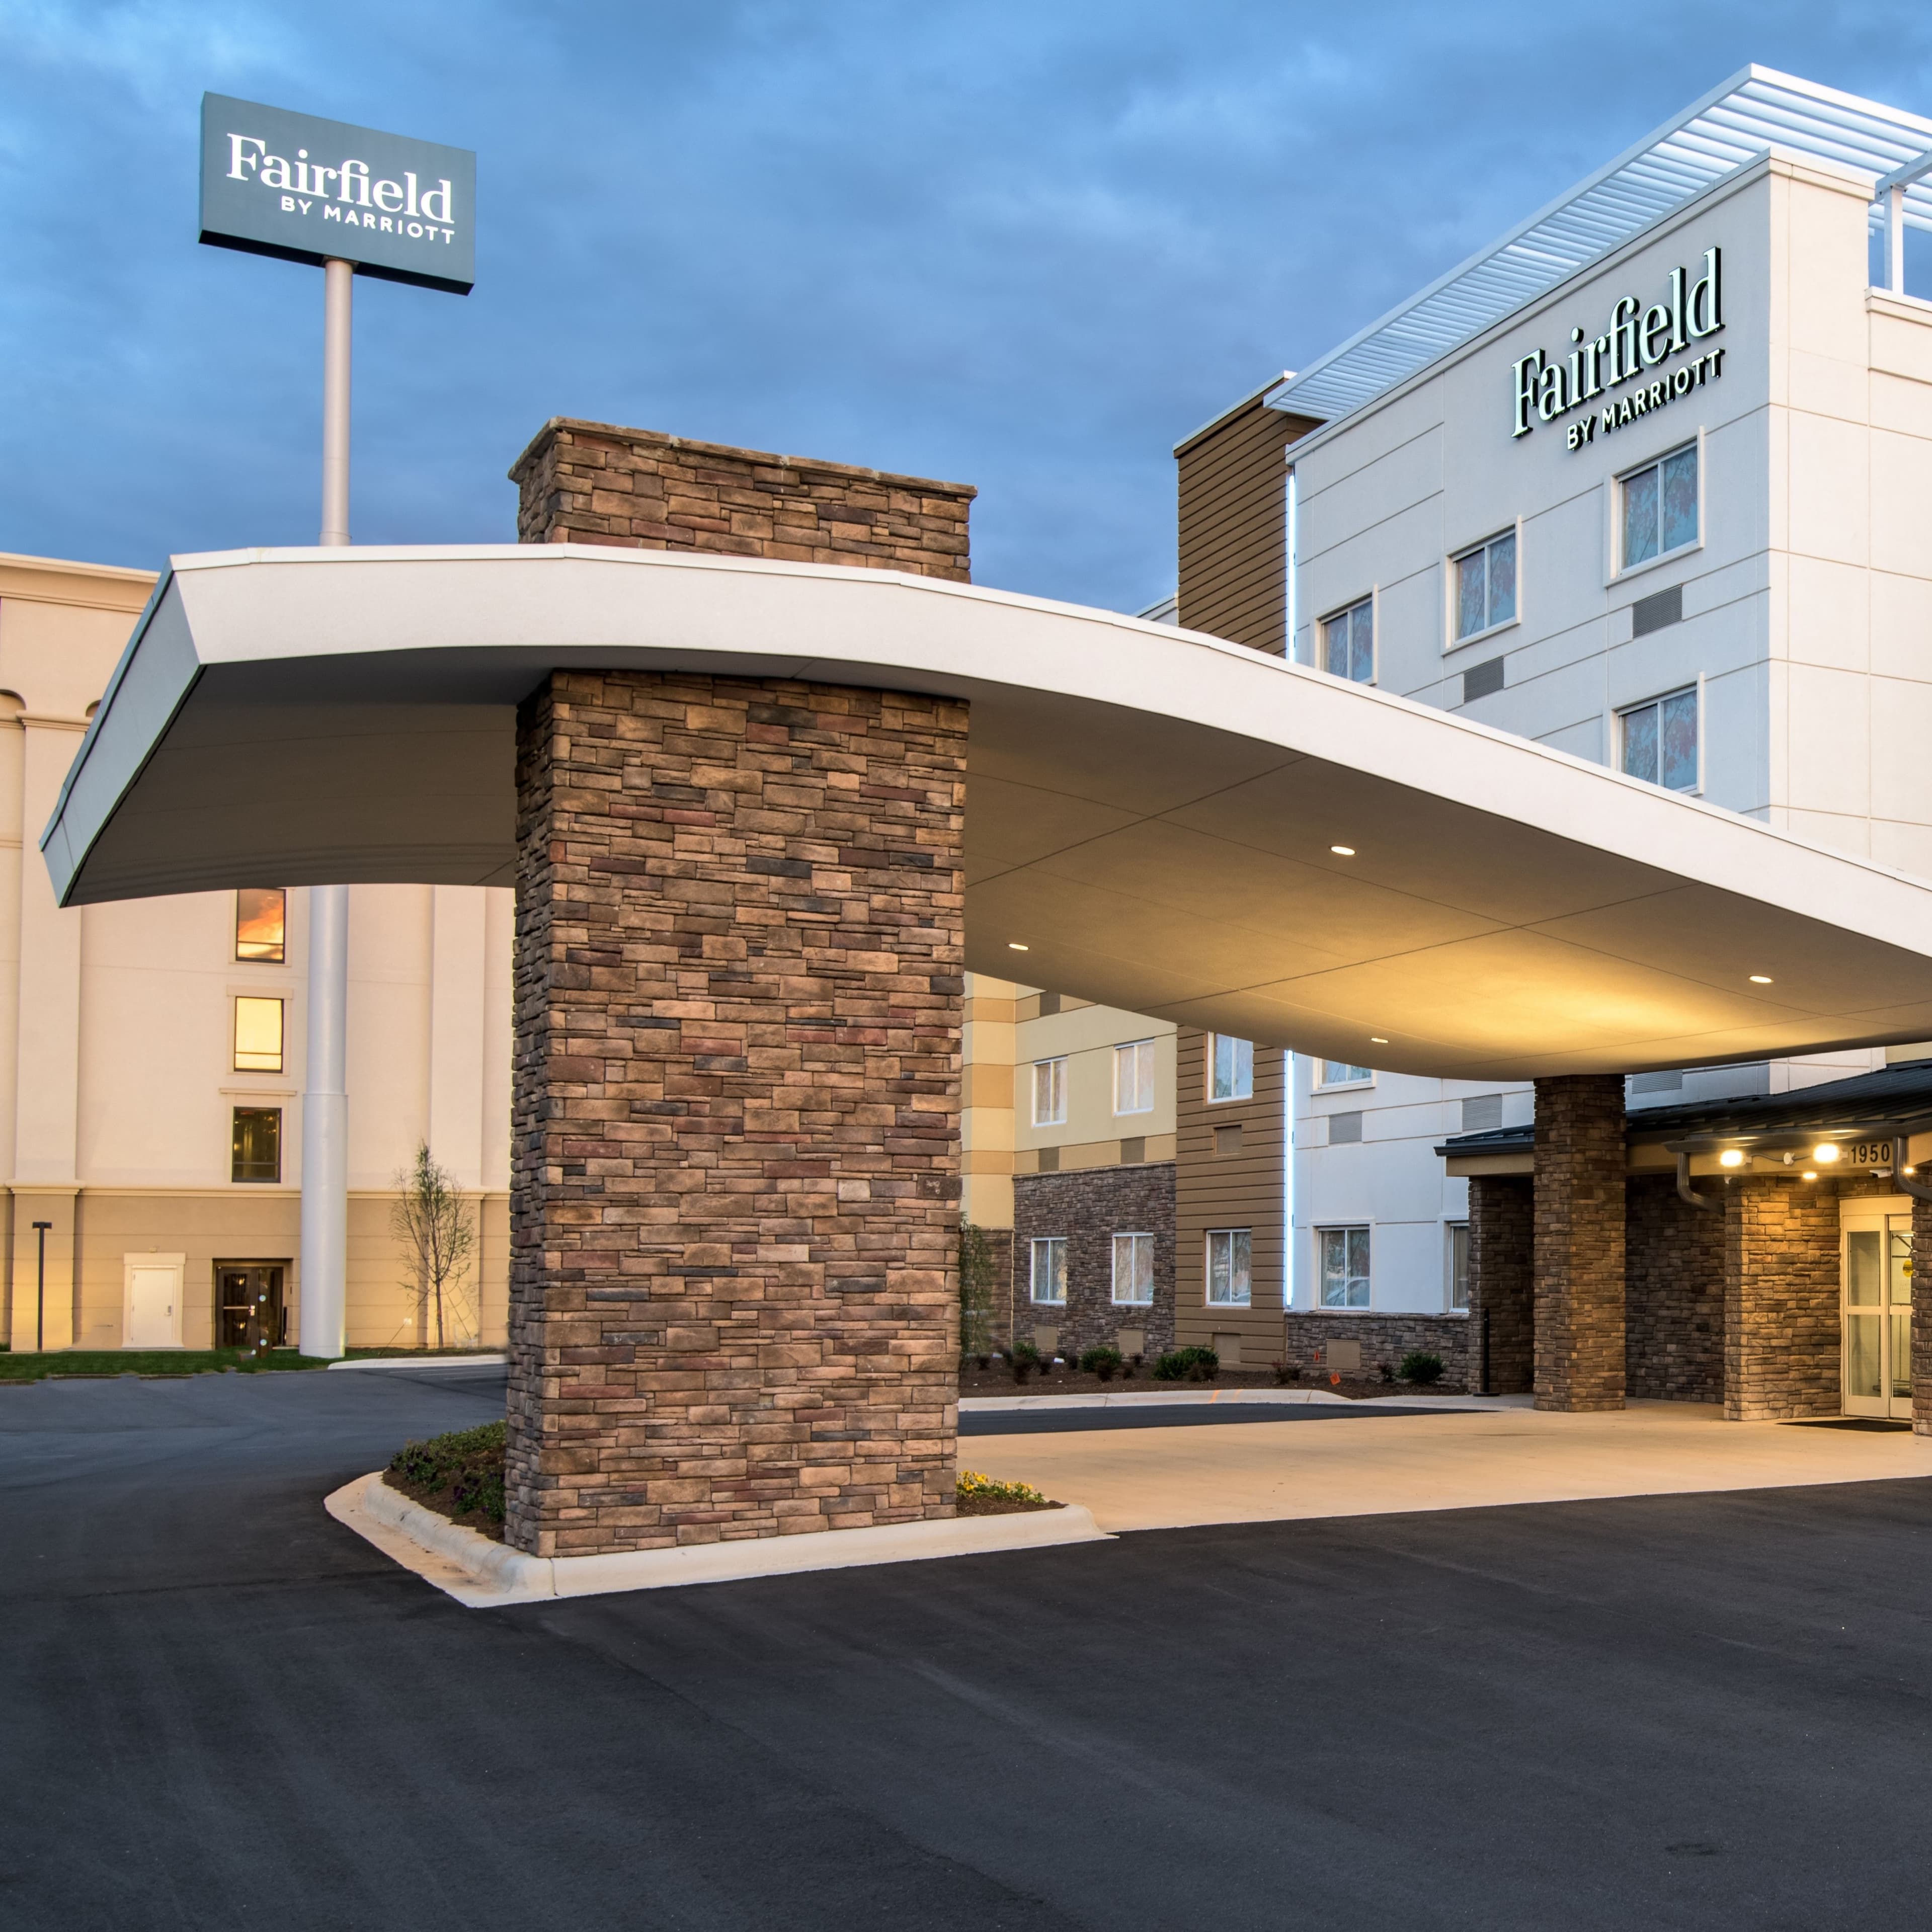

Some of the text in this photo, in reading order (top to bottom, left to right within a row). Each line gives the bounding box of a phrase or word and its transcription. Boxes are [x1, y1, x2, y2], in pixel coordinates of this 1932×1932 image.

[226, 133, 455, 224] Fairfield
[281, 195, 455, 244] BY MARRIOTT
[1511, 246, 1726, 438] Fairfield
[1567, 348, 1726, 451] BY MARRIOTT
[1851, 1143, 1890, 1164] 1950
